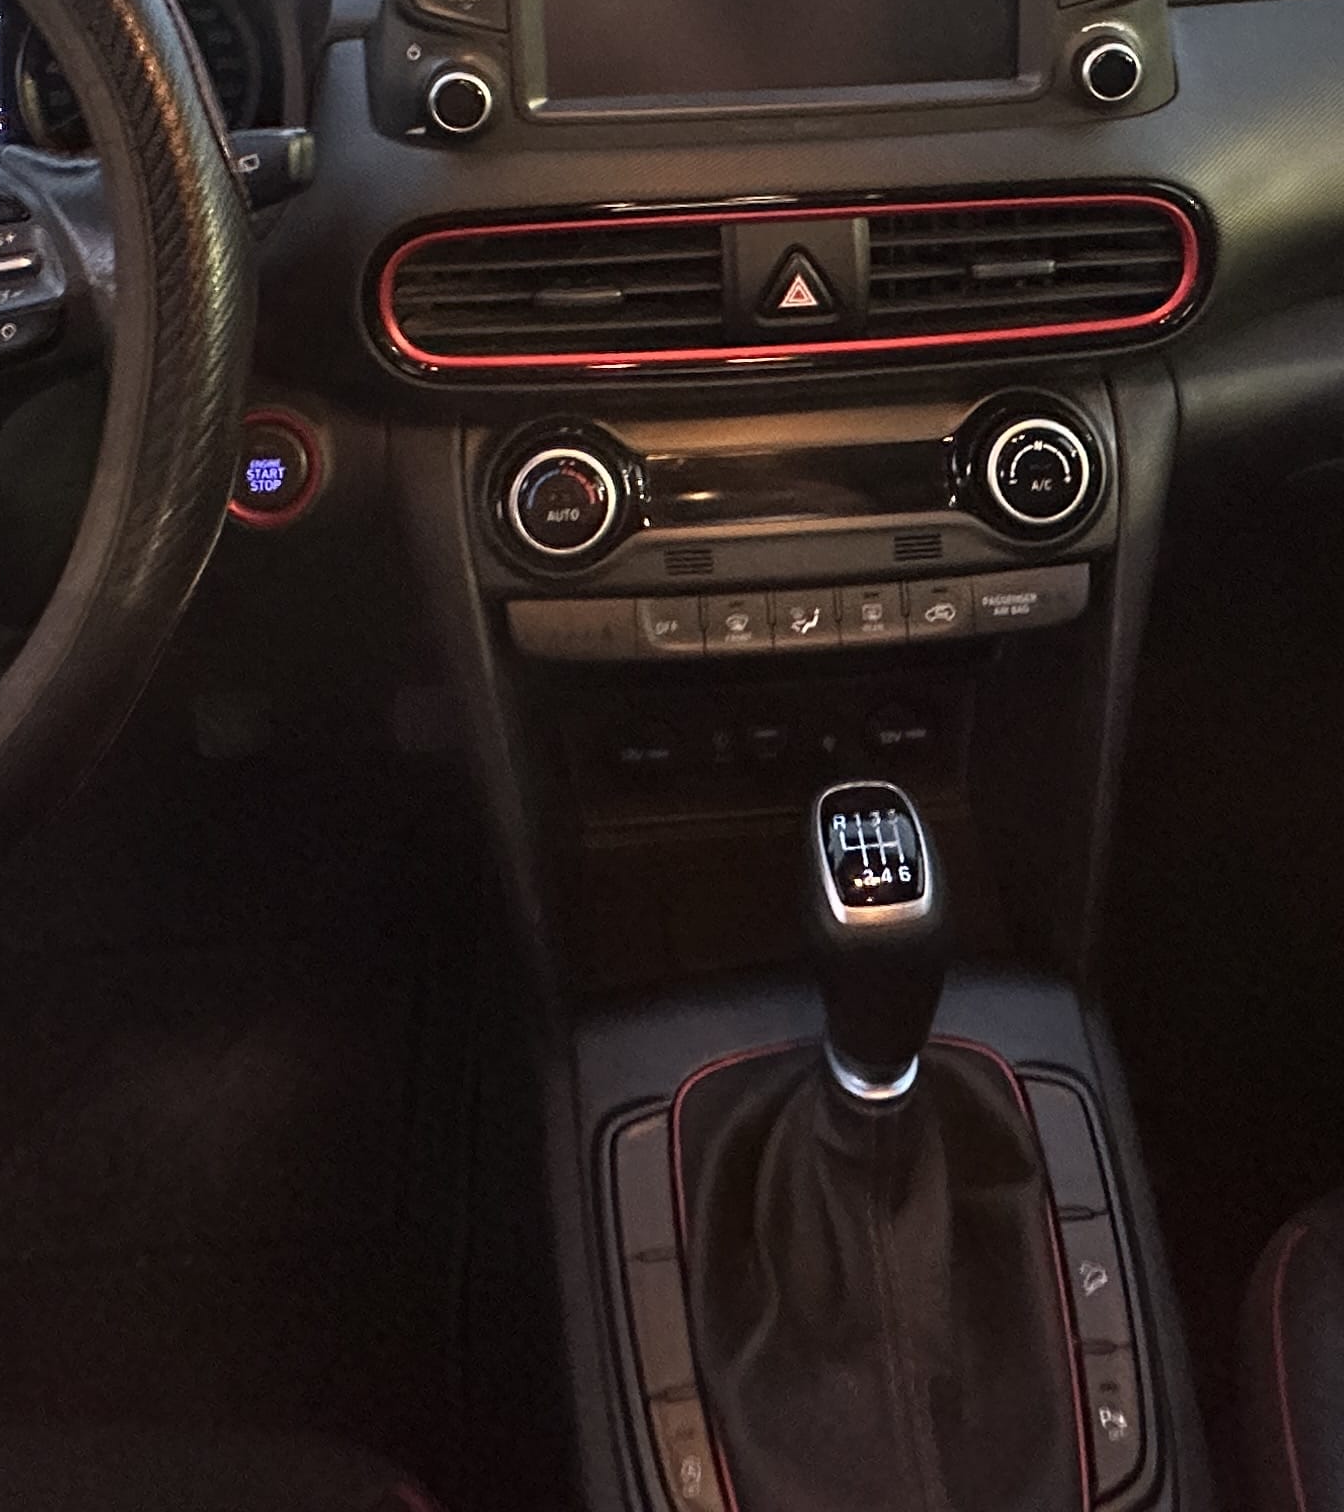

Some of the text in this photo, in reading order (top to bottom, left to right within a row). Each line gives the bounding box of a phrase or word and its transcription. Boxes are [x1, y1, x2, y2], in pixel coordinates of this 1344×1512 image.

[246, 467, 286, 480] START
[250, 479, 282, 492] STOP
[1030, 478, 1053, 492] A/C
[547, 508, 580, 522] AUTO
[832, 814, 846, 830] R
[854, 811, 862, 827] 1
[868, 809, 882, 827] 3
[861, 865, 912, 886] 2 4 6
